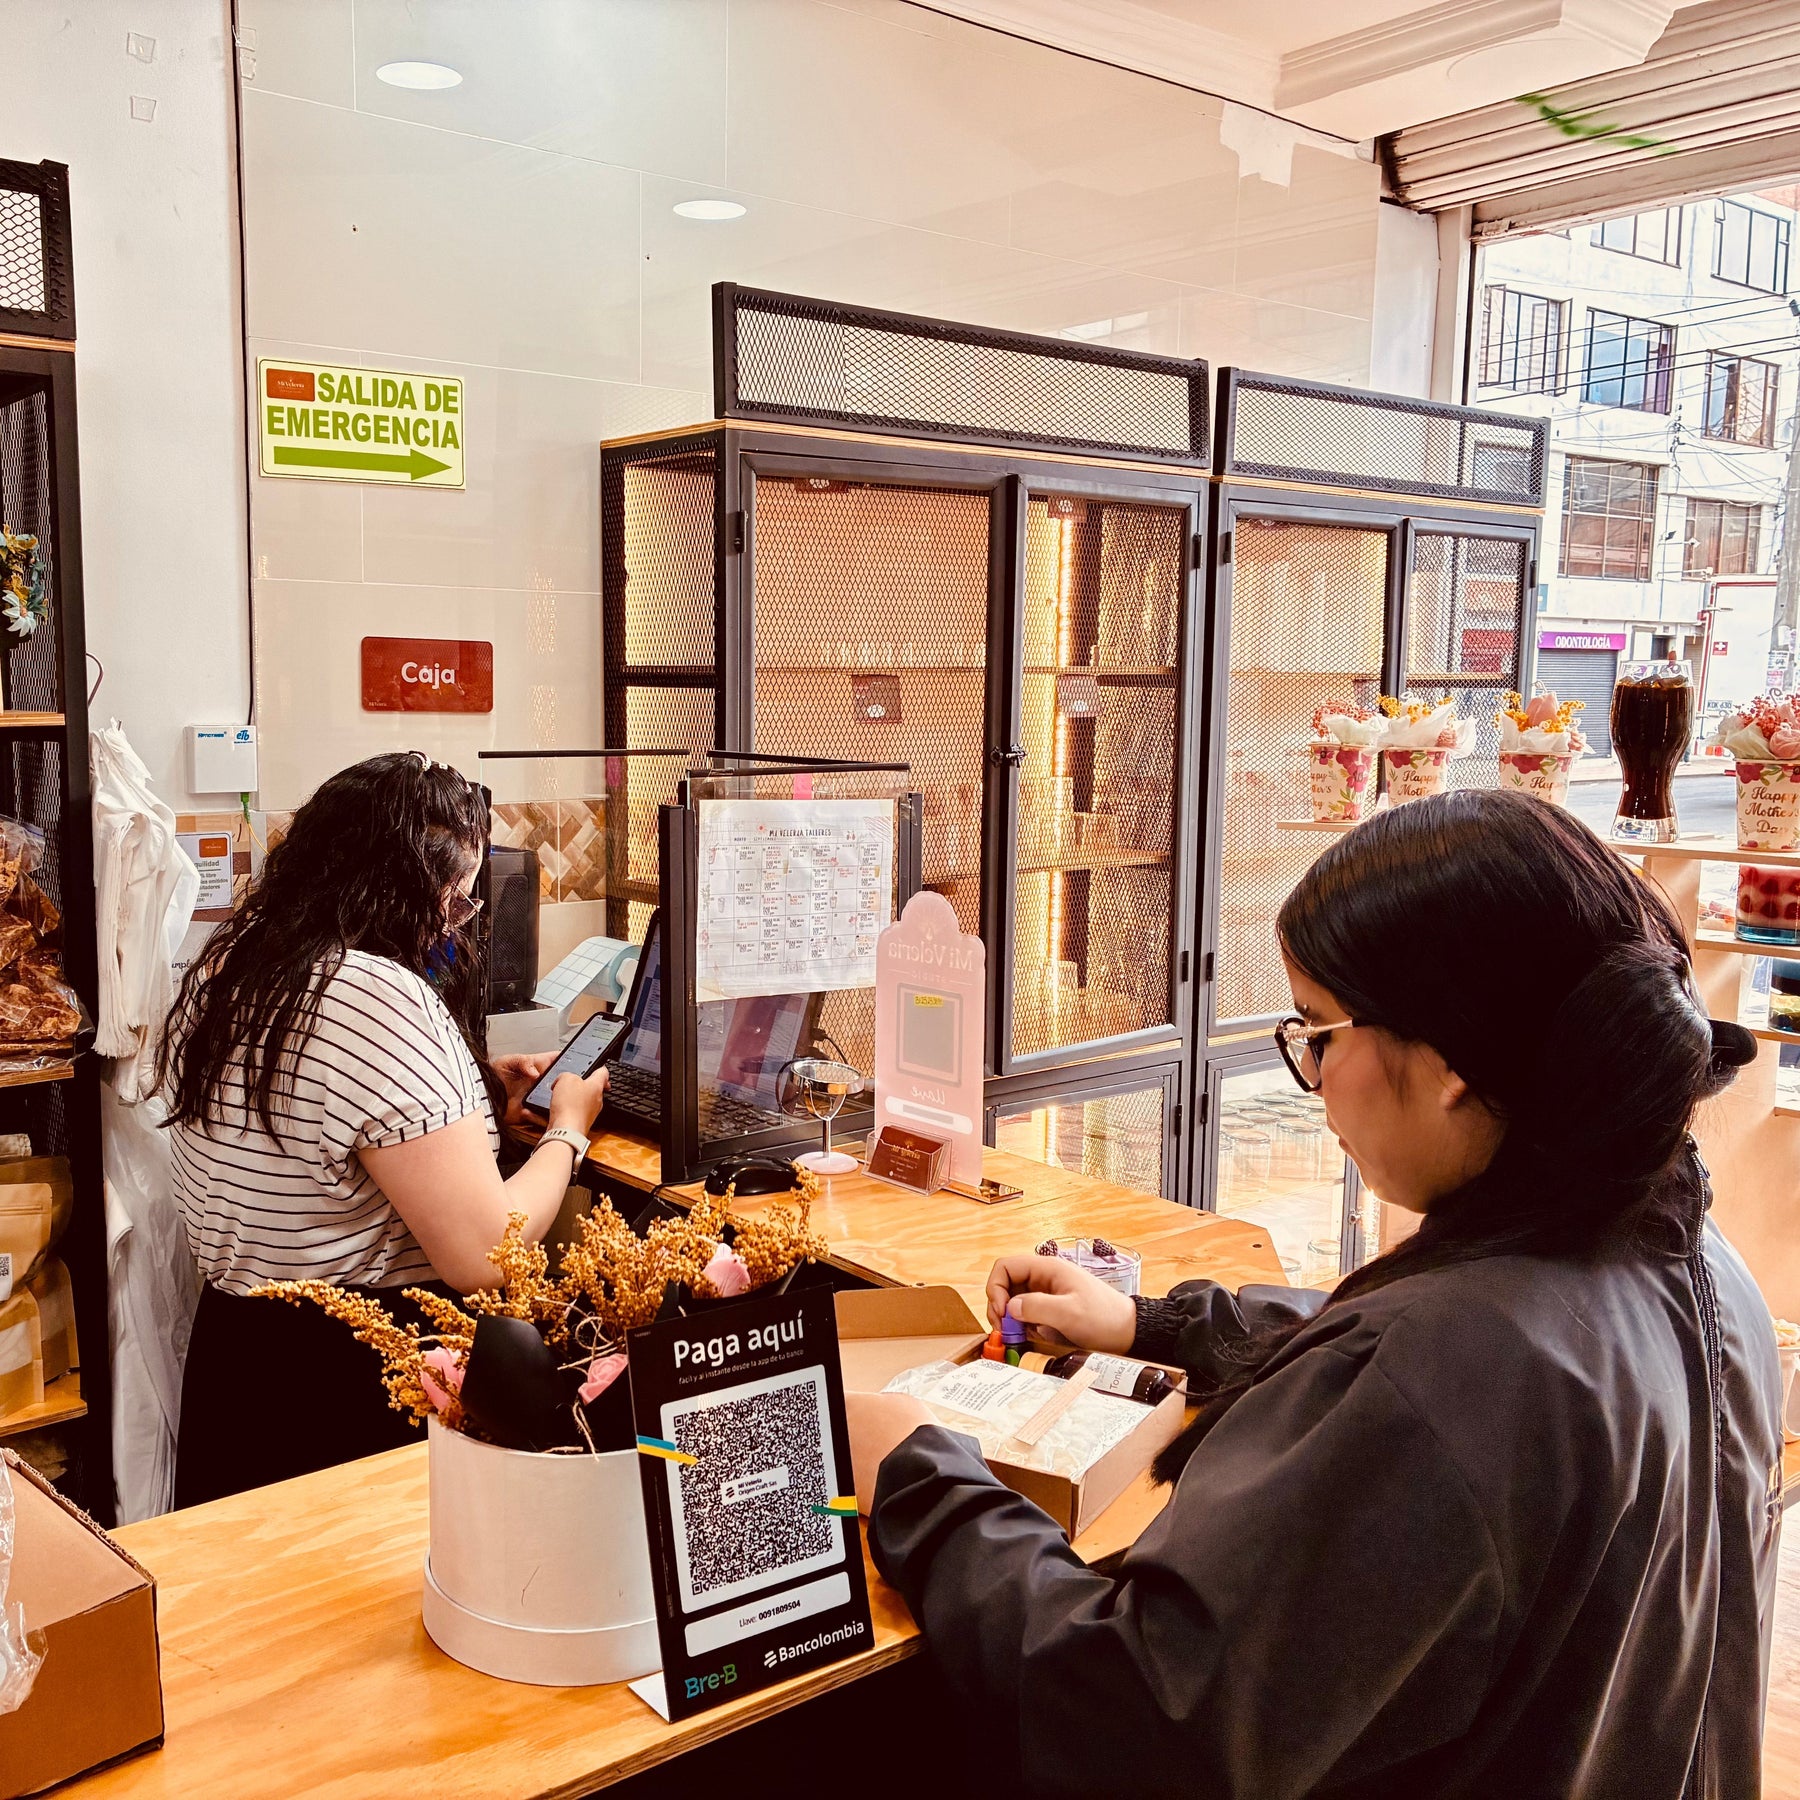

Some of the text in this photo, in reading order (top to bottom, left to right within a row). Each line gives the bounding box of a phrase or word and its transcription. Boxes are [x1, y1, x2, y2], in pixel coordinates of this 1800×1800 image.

[317, 372, 459, 414] SALIDA DE
[266, 405, 460, 449] EMERGENCIA
[1555, 634, 1611, 649] ODONTOLOGÍA
[401, 661, 455, 689] Caja
[1751, 786, 1798, 804] Happy
[805, 828, 832, 837] TALLERES
[1756, 819, 1789, 834] Day
[673, 1309, 804, 1369] Paga aquí
[705, 1366, 731, 1379] instante
[731, 1361, 751, 1372] desde
[750, 1359, 757, 1367] la
[757, 1356, 770, 1366] app
[769, 1355, 778, 1364] de
[786, 1349, 804, 1360] banco
[1109, 1366, 1126, 1390] Tonka
[738, 1486, 756, 1496] Origen
[755, 1482, 768, 1490] Craft
[738, 1599, 801, 1628] Llave: 0091809504
[778, 1620, 865, 1663] Bancolombia
[684, 1663, 738, 1699] Bre-B
